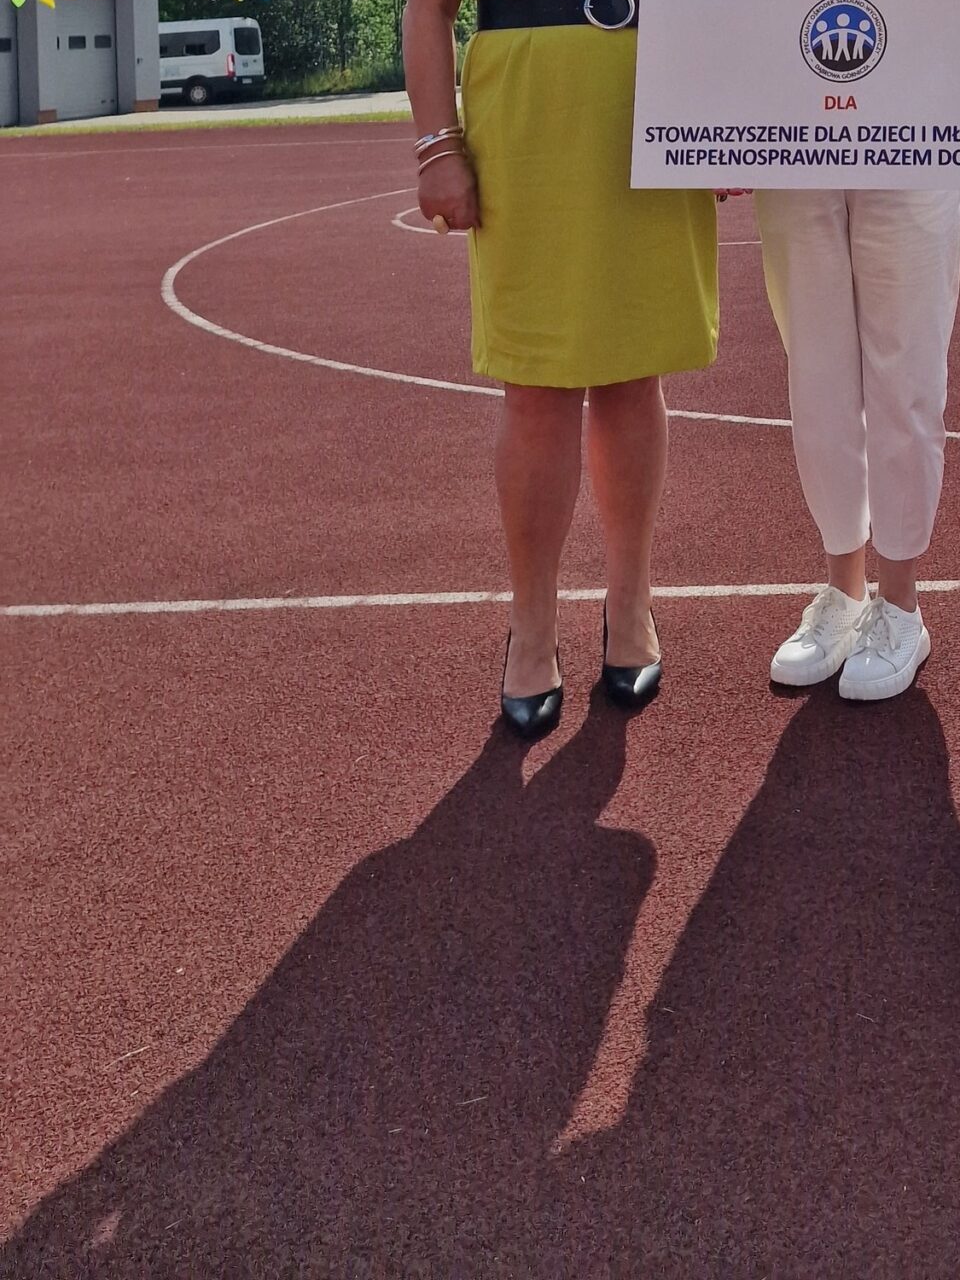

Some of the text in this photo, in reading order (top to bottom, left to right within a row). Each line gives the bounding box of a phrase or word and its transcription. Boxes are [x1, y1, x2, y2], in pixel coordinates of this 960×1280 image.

[824, 96, 857, 110] DLA
[645, 126, 809, 143] STOWARZYSZENIE
[814, 126, 852, 142] DLA
[858, 126, 915, 142] DZIECI
[921, 126, 926, 142] I
[665, 149, 858, 166] NIEPEŁNOSPRAWNEJ
[864, 149, 932, 166] RAZEM
